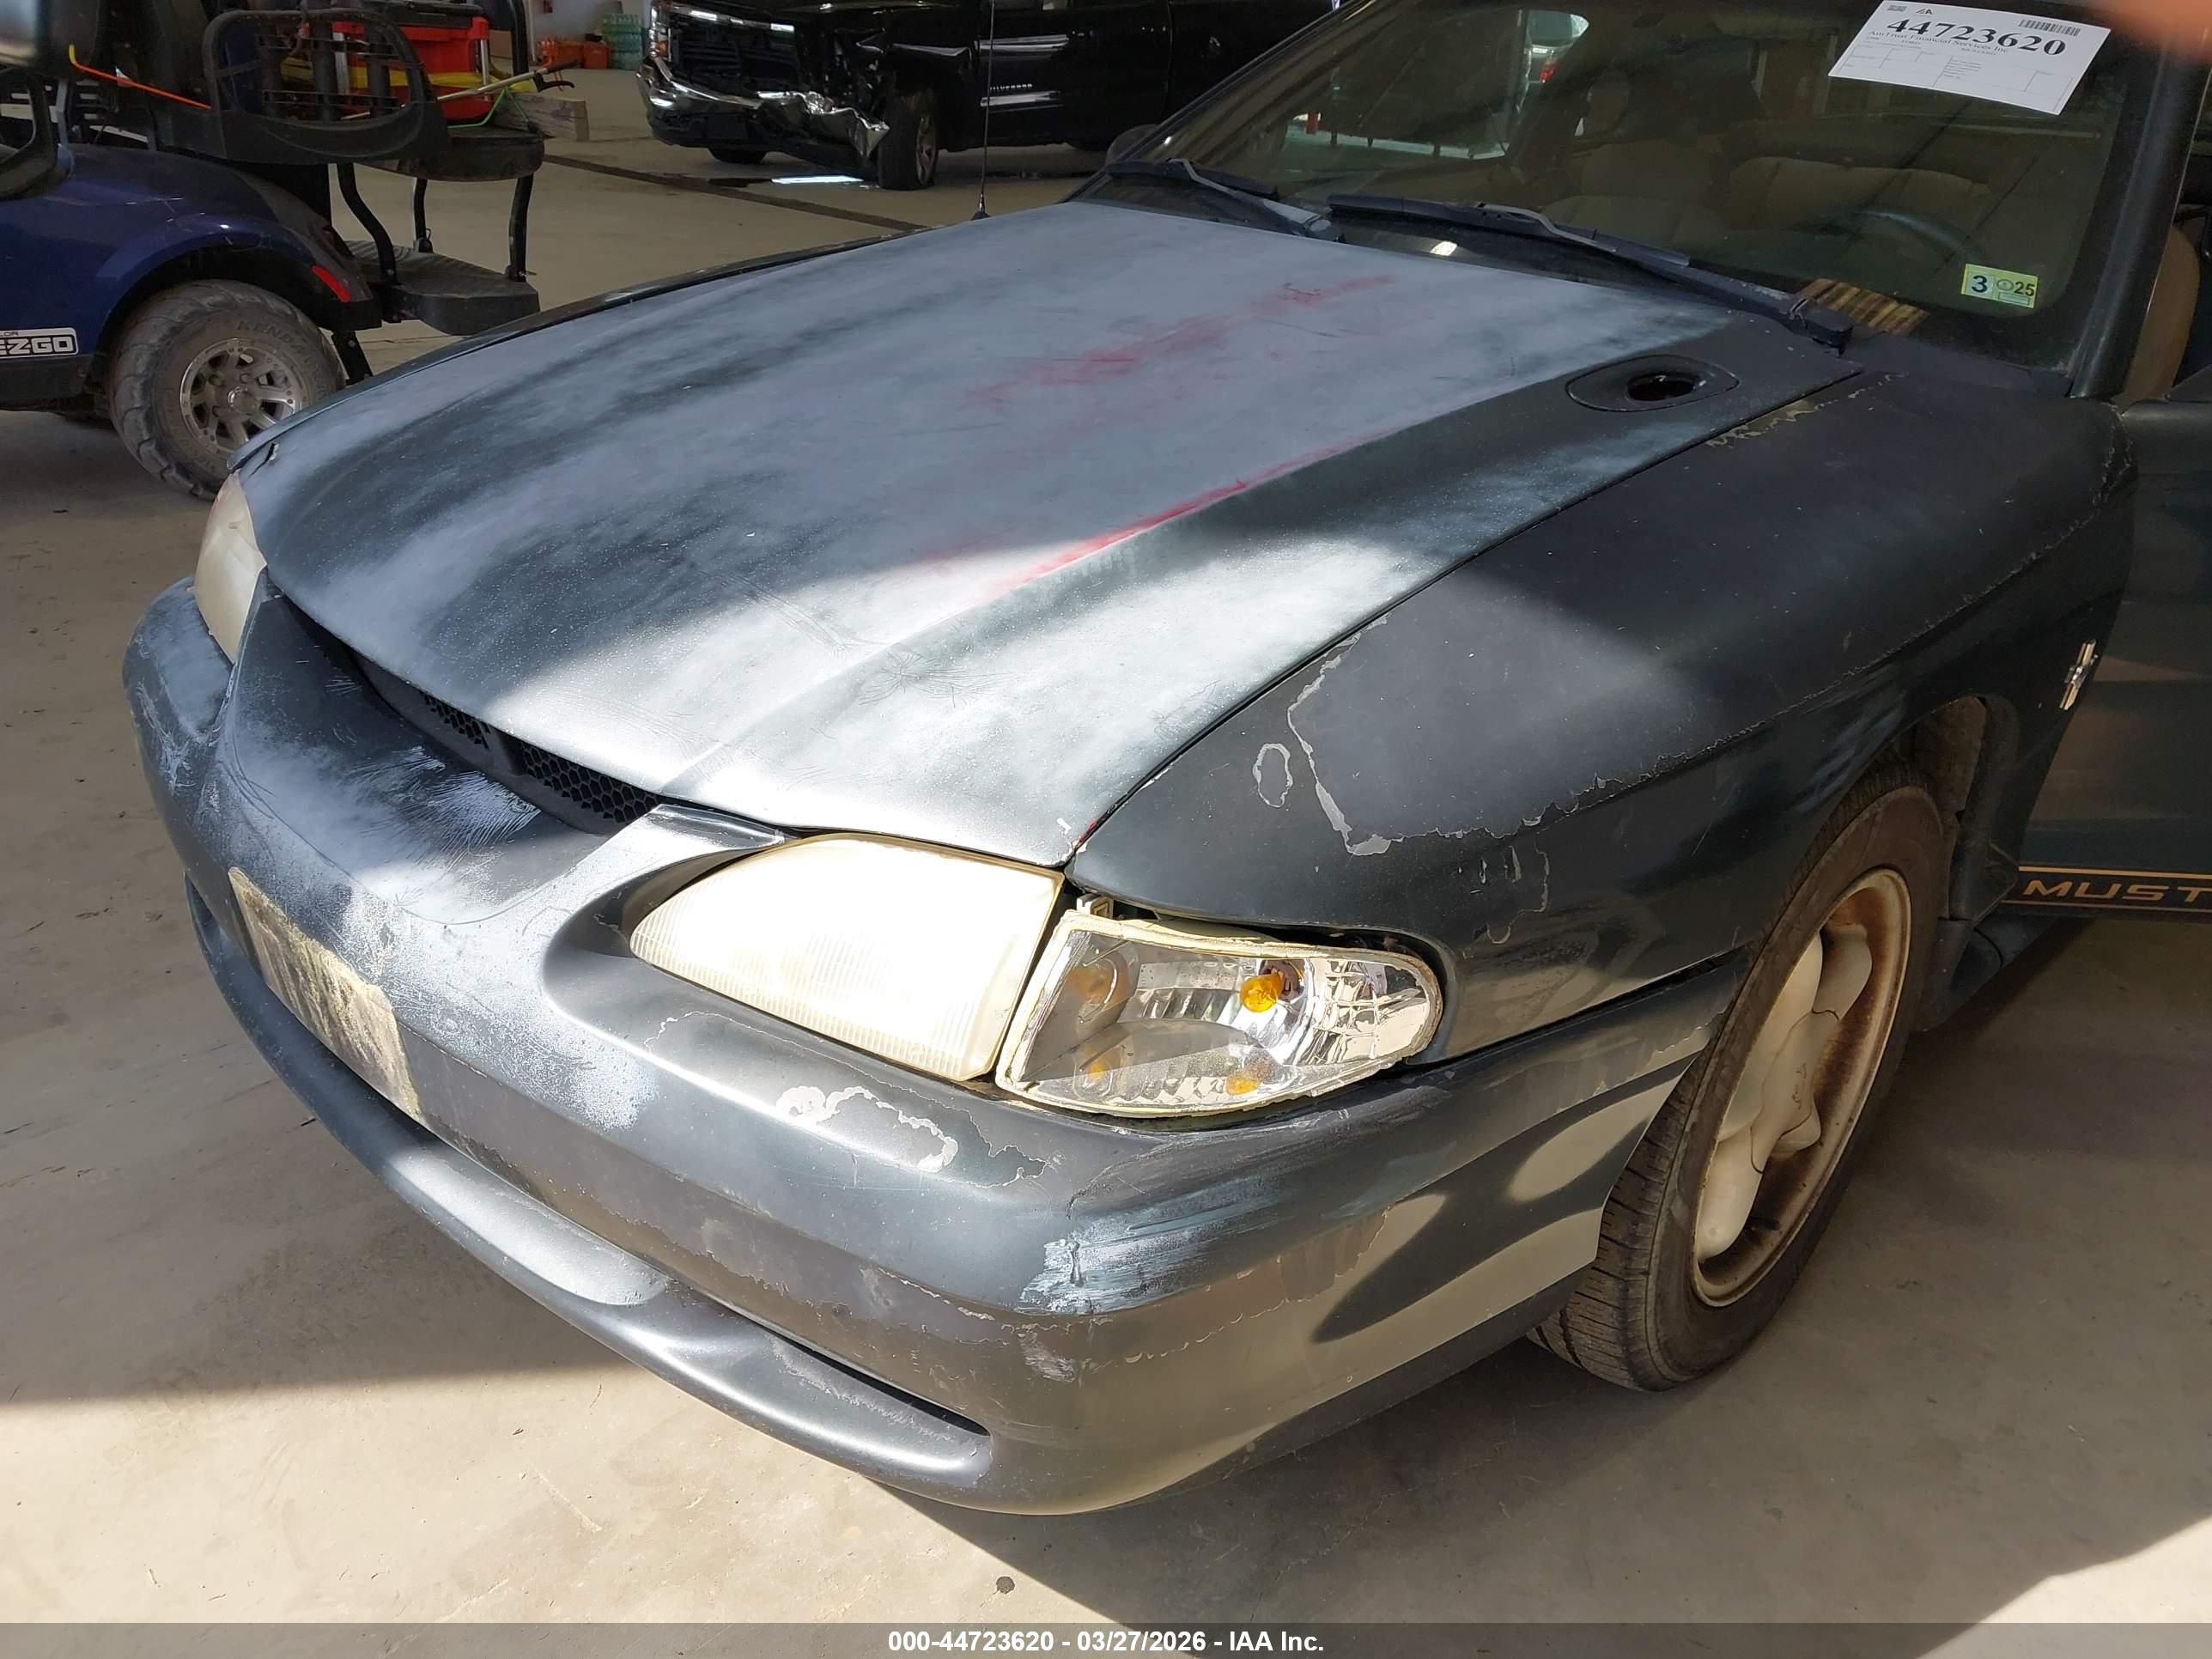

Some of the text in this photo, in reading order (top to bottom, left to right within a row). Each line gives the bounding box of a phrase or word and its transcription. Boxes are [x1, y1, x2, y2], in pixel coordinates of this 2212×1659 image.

[1869, 31, 1907, 40] AmTrust
[1910, 34, 1952, 45] Financial
[1954, 40, 1992, 51] Services
[1887, 19, 2066, 55] 44723620
[1971, 275, 2035, 297] 3 25
[2022, 879, 2212, 903] MUST
